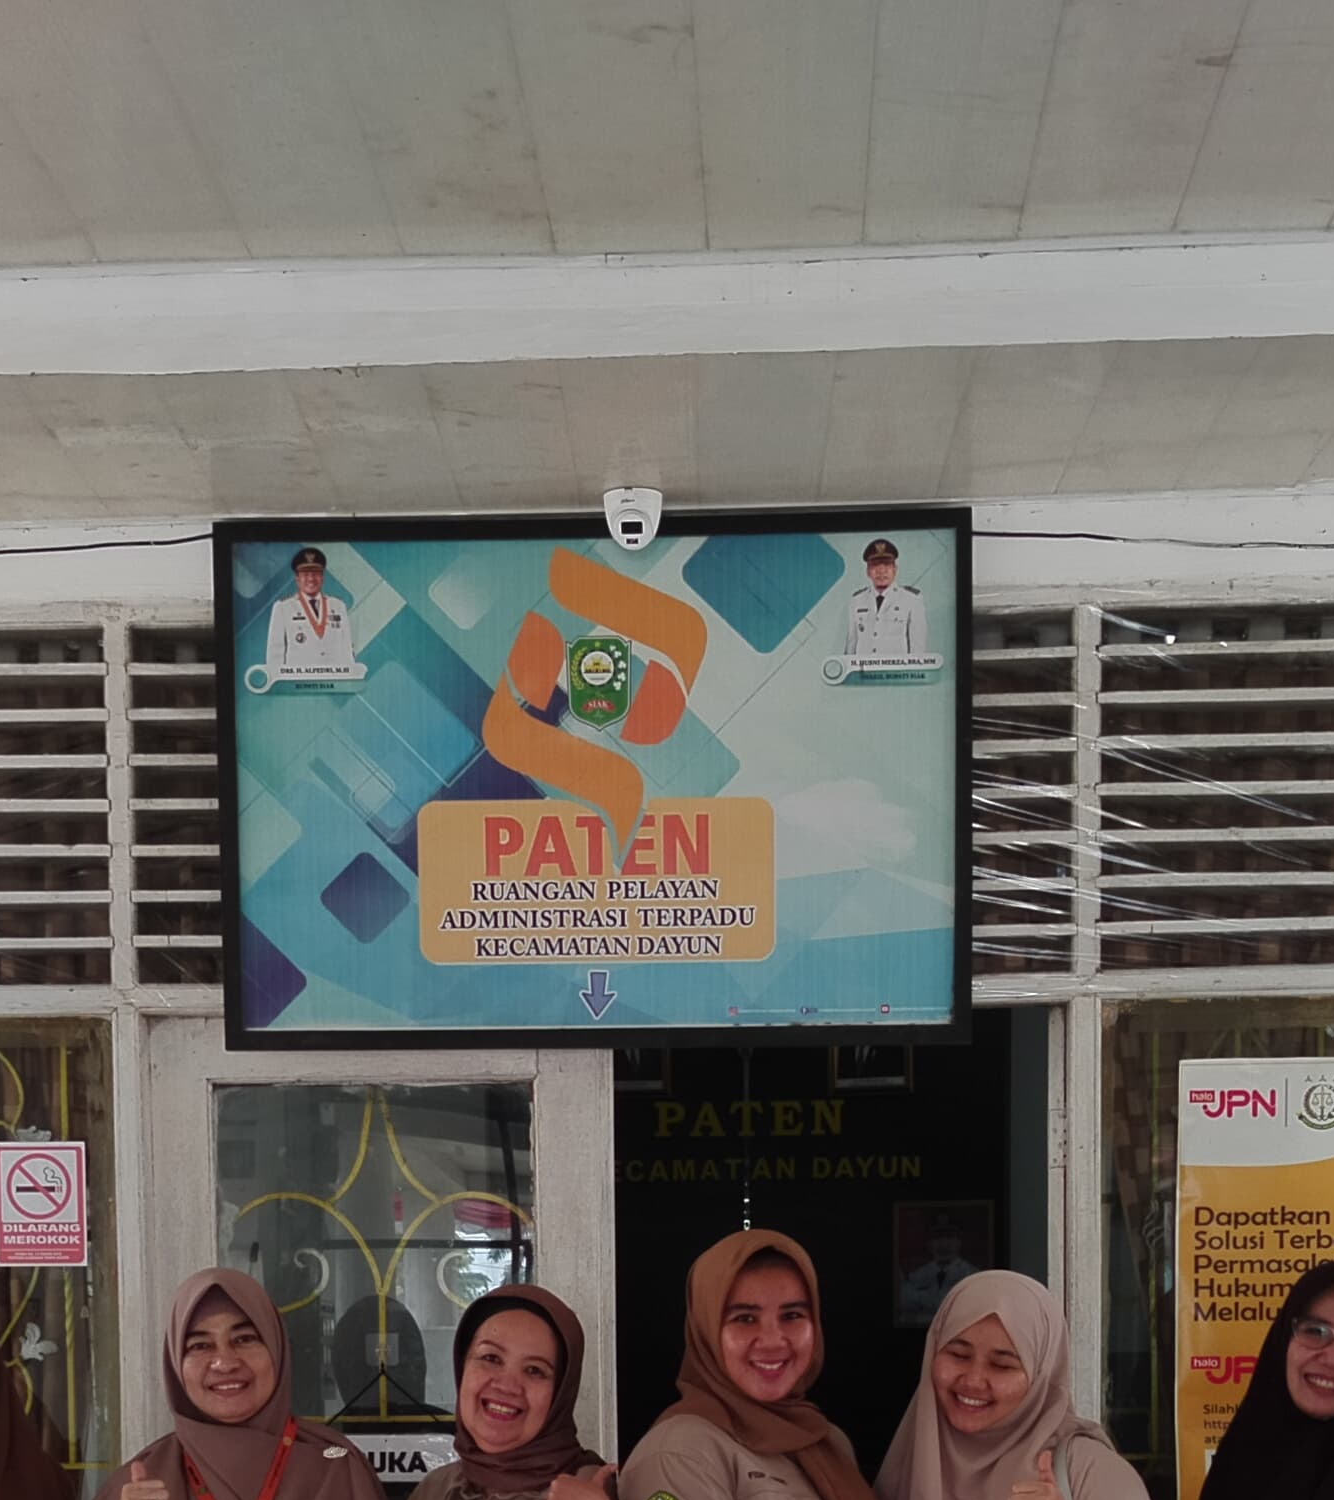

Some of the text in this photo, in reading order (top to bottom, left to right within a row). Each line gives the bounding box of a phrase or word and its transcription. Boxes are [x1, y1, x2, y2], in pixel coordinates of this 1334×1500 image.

[483, 813, 711, 877] PATEN
[472, 879, 719, 902] RUANGAN PELAYAN
[440, 907, 756, 930] ADMINISTRASI TERPADU
[475, 934, 722, 957] KECAMATAN DAYUN
[1191, 1089, 1276, 1118] halo JPN
[654, 1100, 845, 1138] PATEN
[615, 1154, 922, 1183] CAMATAN DAYUN
[2, 1223, 81, 1233] DILARANG
[1194, 1205, 1331, 1230] Dapatkan
[3, 1235, 81, 1245] MEROKOK
[1194, 1230, 1265, 1251] Solusi
[1193, 1277, 1293, 1298] Hukum
[1193, 1301, 1280, 1322] Melalu
[1193, 1355, 1260, 1385] halo JP
[1202, 1403, 1238, 1415] Silah
[368, 1451, 428, 1474] UKA
